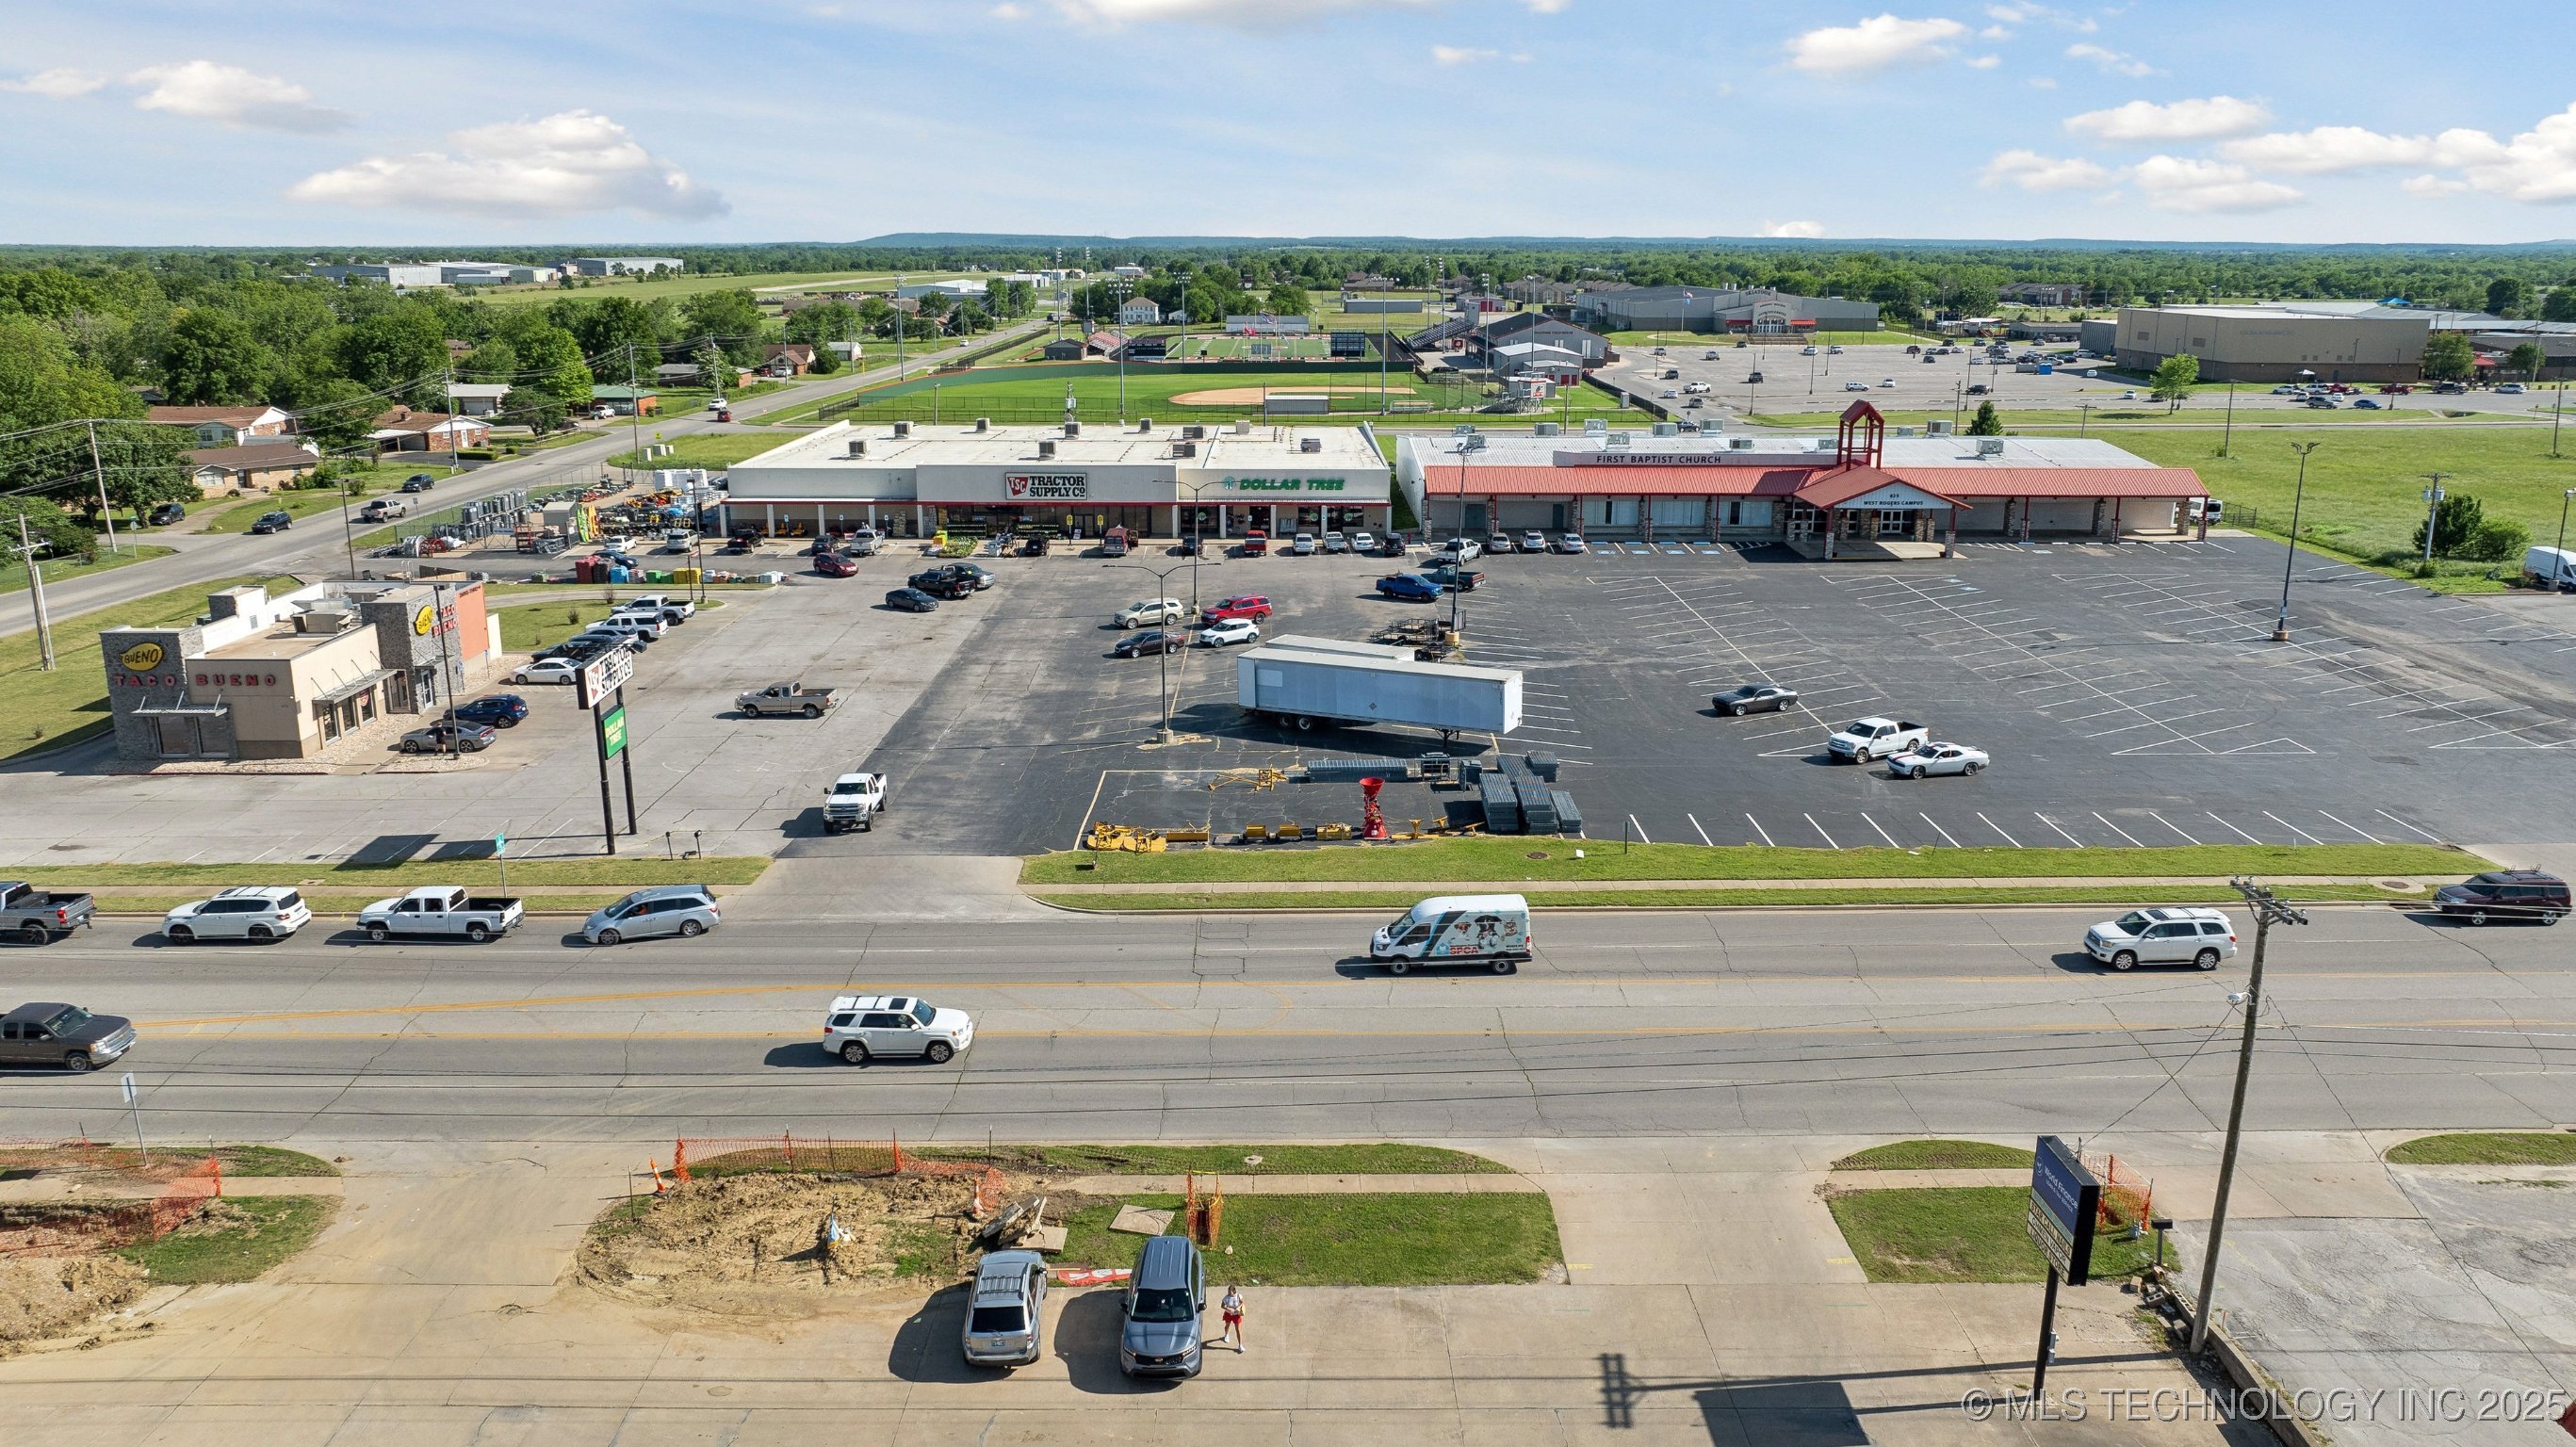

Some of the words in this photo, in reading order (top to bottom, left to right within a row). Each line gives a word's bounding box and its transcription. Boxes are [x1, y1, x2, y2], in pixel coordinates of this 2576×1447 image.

[1009, 477, 1026, 493] TSC
[1029, 476, 1084, 486] TRACTOR
[1240, 479, 1300, 490] DOLLAR
[1307, 480, 1345, 490] TREE
[1029, 487, 1070, 496] SUPPLY
[124, 648, 162, 664] BUENO
[113, 675, 176, 688] TACO
[195, 674, 277, 687] BUENO
[2045, 1166, 2058, 1187] World
[2058, 1181, 2078, 1209] Finance
[2030, 1201, 2043, 1222] STAR
[2030, 1227, 2048, 1255] LIQUOR
[2047, 1249, 2065, 1277] STORE
[2049, 1238, 2066, 1264] VAPOR
